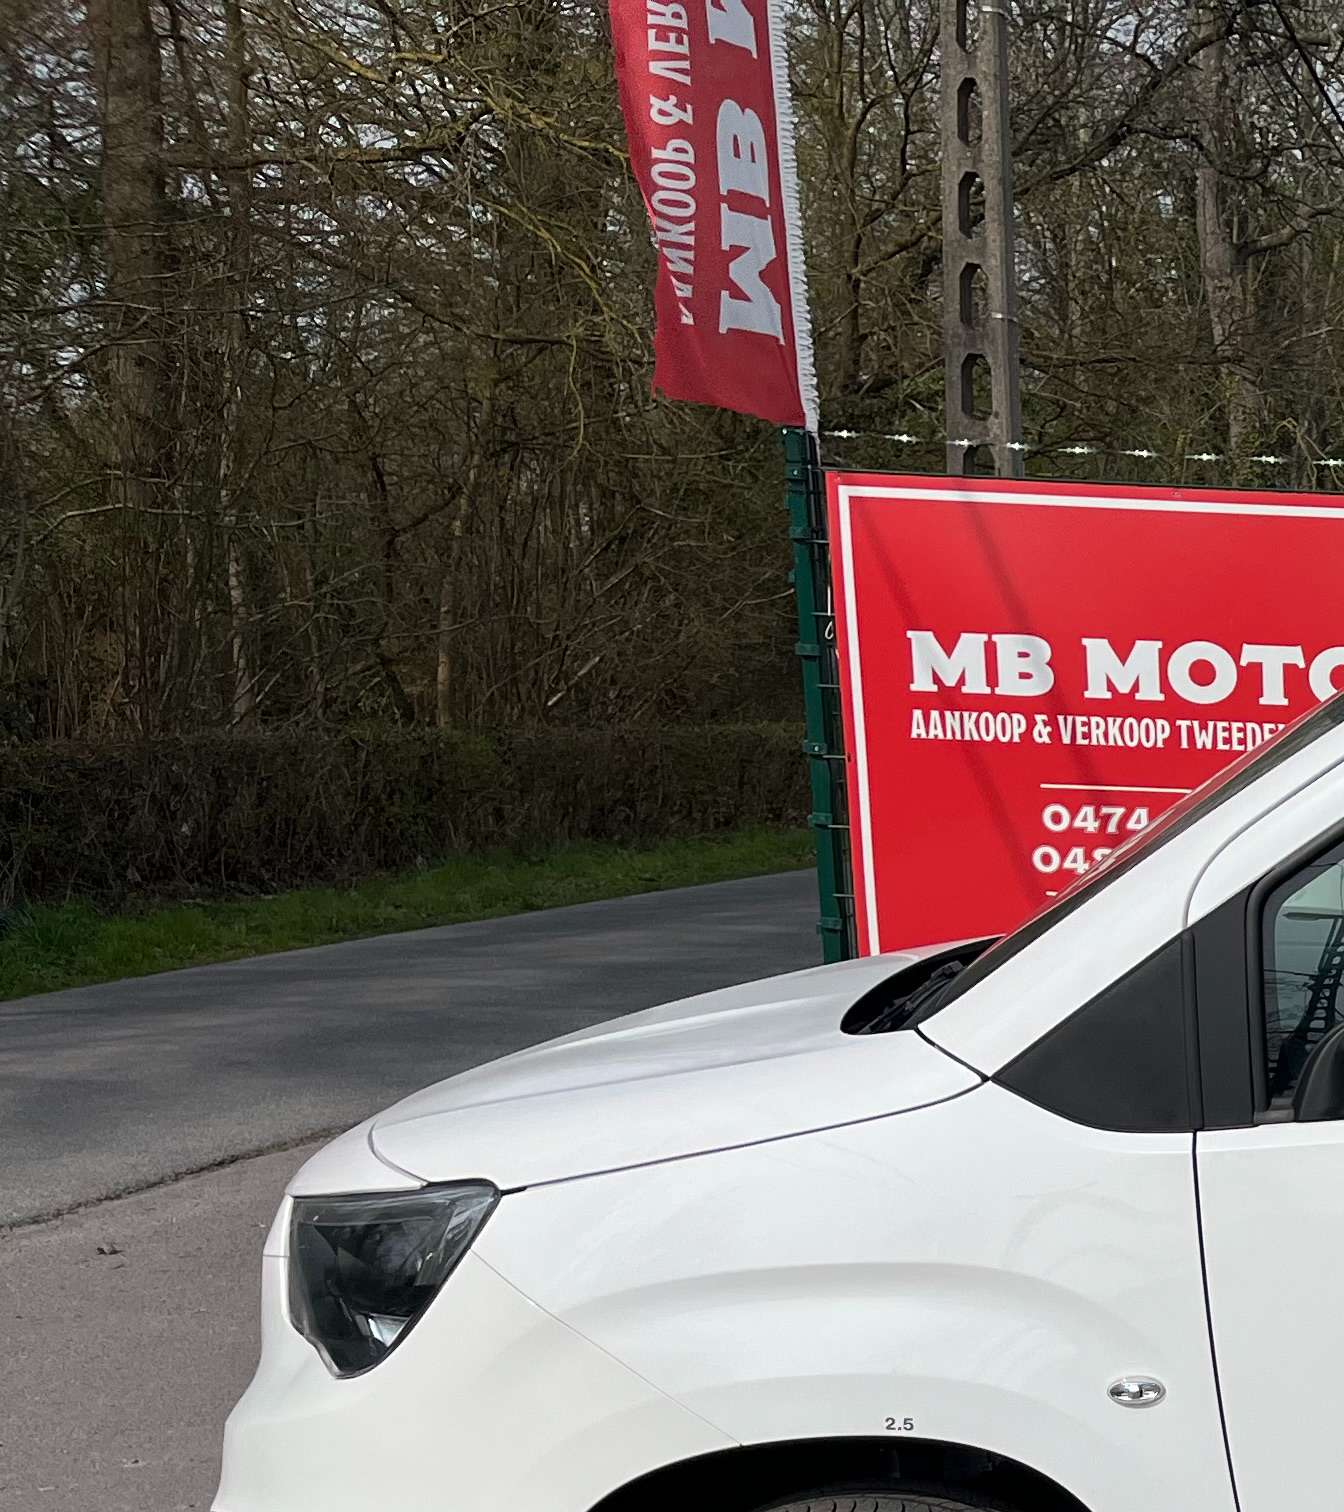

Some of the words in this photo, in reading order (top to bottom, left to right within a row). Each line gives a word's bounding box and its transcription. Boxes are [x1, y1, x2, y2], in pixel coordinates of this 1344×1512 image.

[906, 630, 1055, 697] MB
[910, 709, 1028, 743] AANKOOP
[1032, 714, 1052, 744] &
[1057, 714, 1171, 748] VERKOOP
[1175, 719, 1287, 753] TWEEDE
[1042, 803, 1150, 834] 0474
[884, 1416, 915, 1432] 2.5
